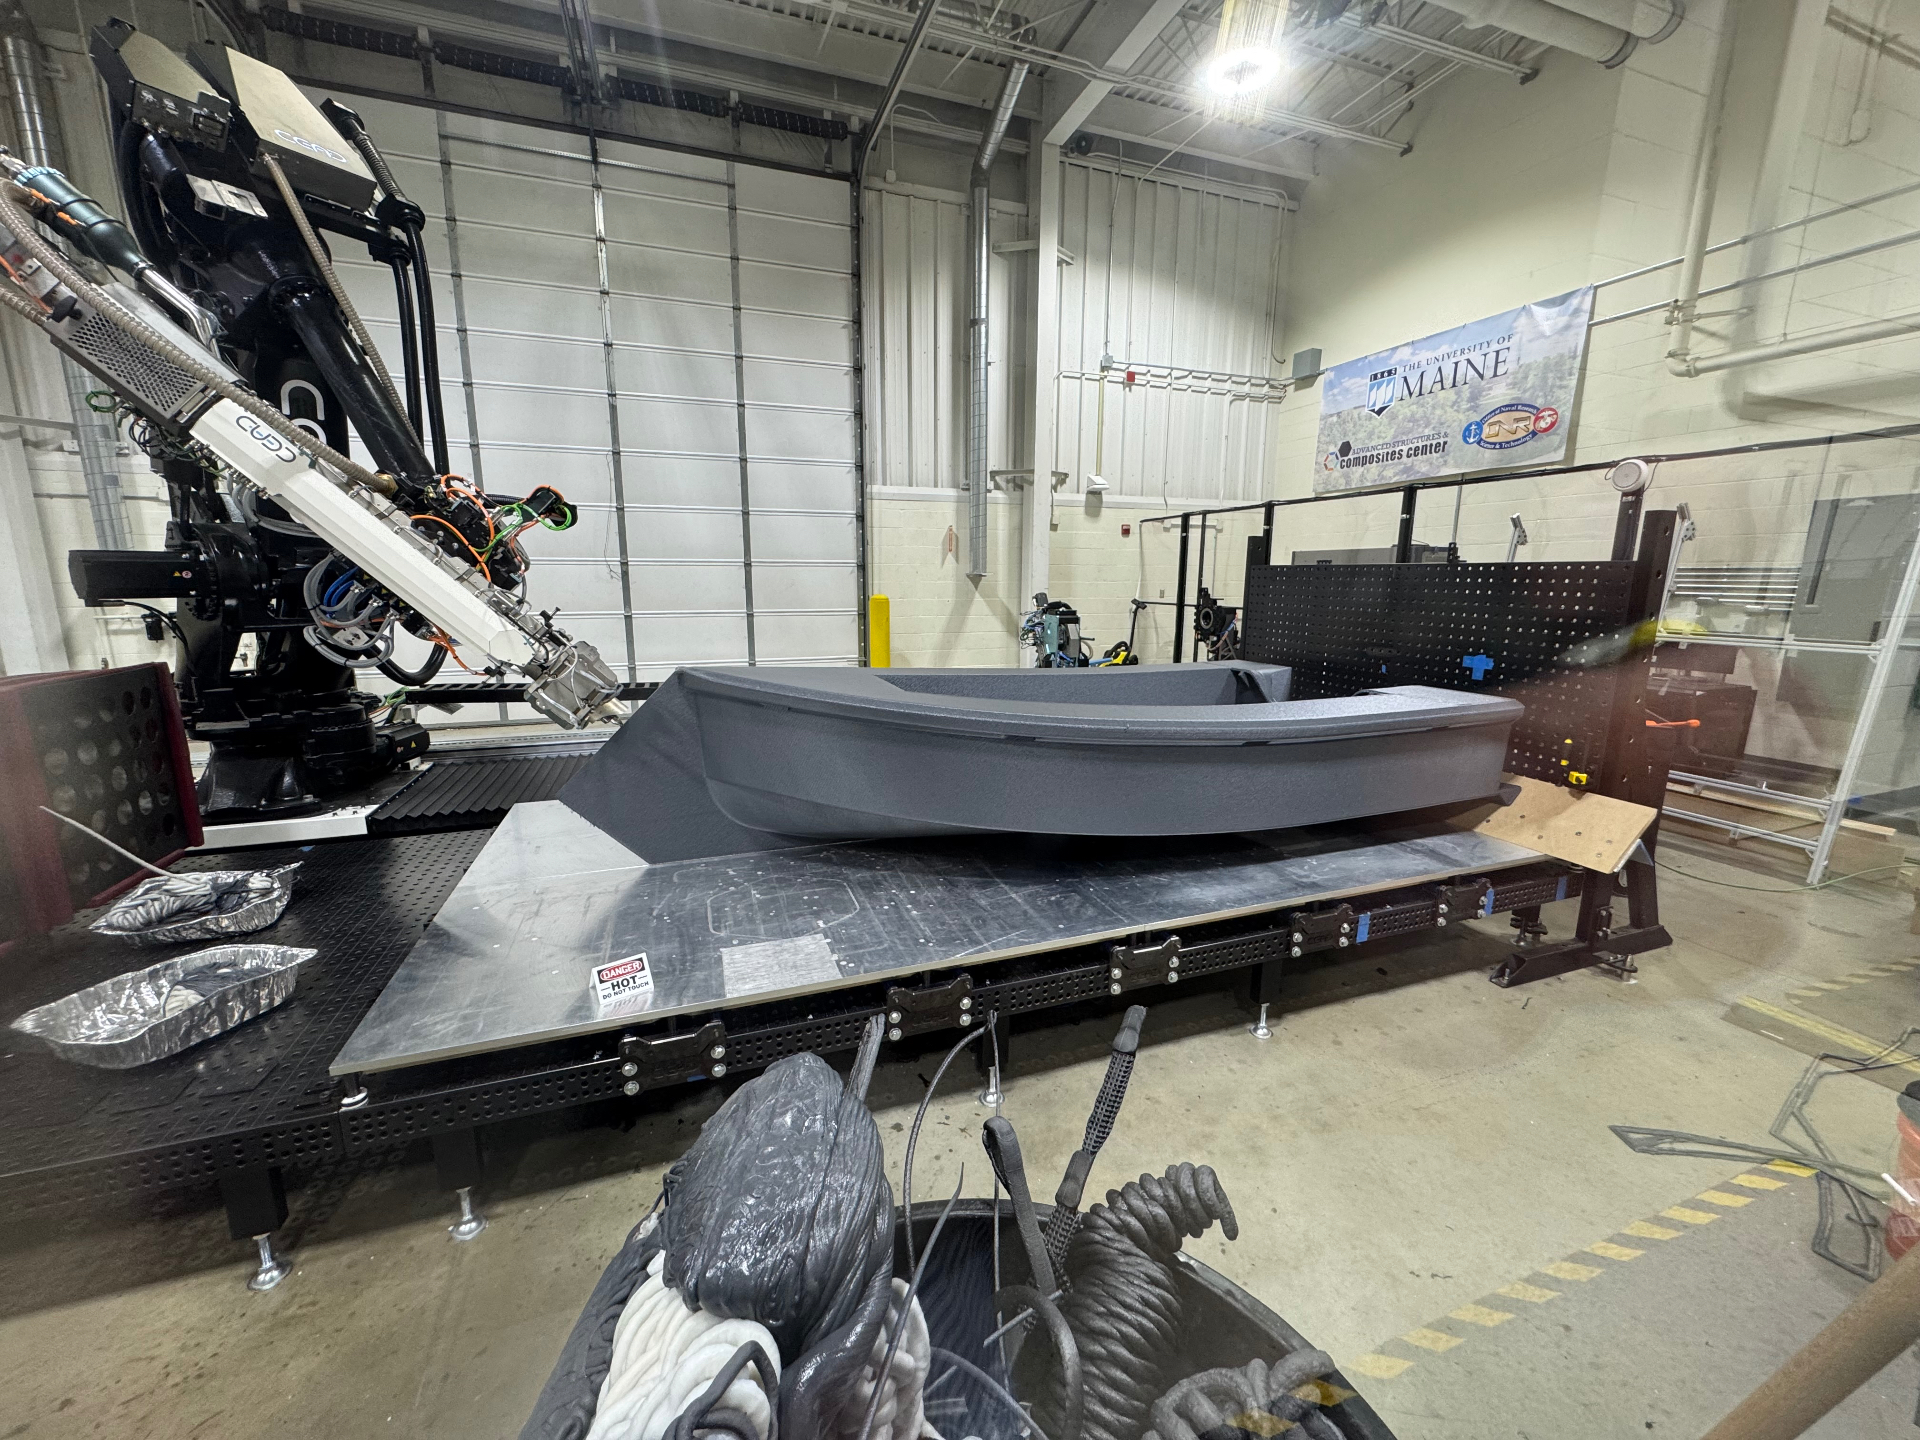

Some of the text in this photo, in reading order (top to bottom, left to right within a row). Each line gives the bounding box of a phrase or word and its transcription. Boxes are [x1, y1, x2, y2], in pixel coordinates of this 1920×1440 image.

[275, 129, 347, 164] CEAD
[1402, 333, 1514, 373] THE UNIVERSITY OF
[1370, 367, 1396, 382] 1865
[1397, 346, 1511, 402] MAINE
[1351, 442, 1392, 456] ADVANCED
[1392, 433, 1442, 448] STRUCTURES
[1501, 433, 1533, 448] Technology
[1339, 440, 1449, 470] composites center
[603, 962, 641, 979] DANGER
[602, 980, 650, 1000] DO NOT TOUCH
[611, 974, 638, 991] HOT
